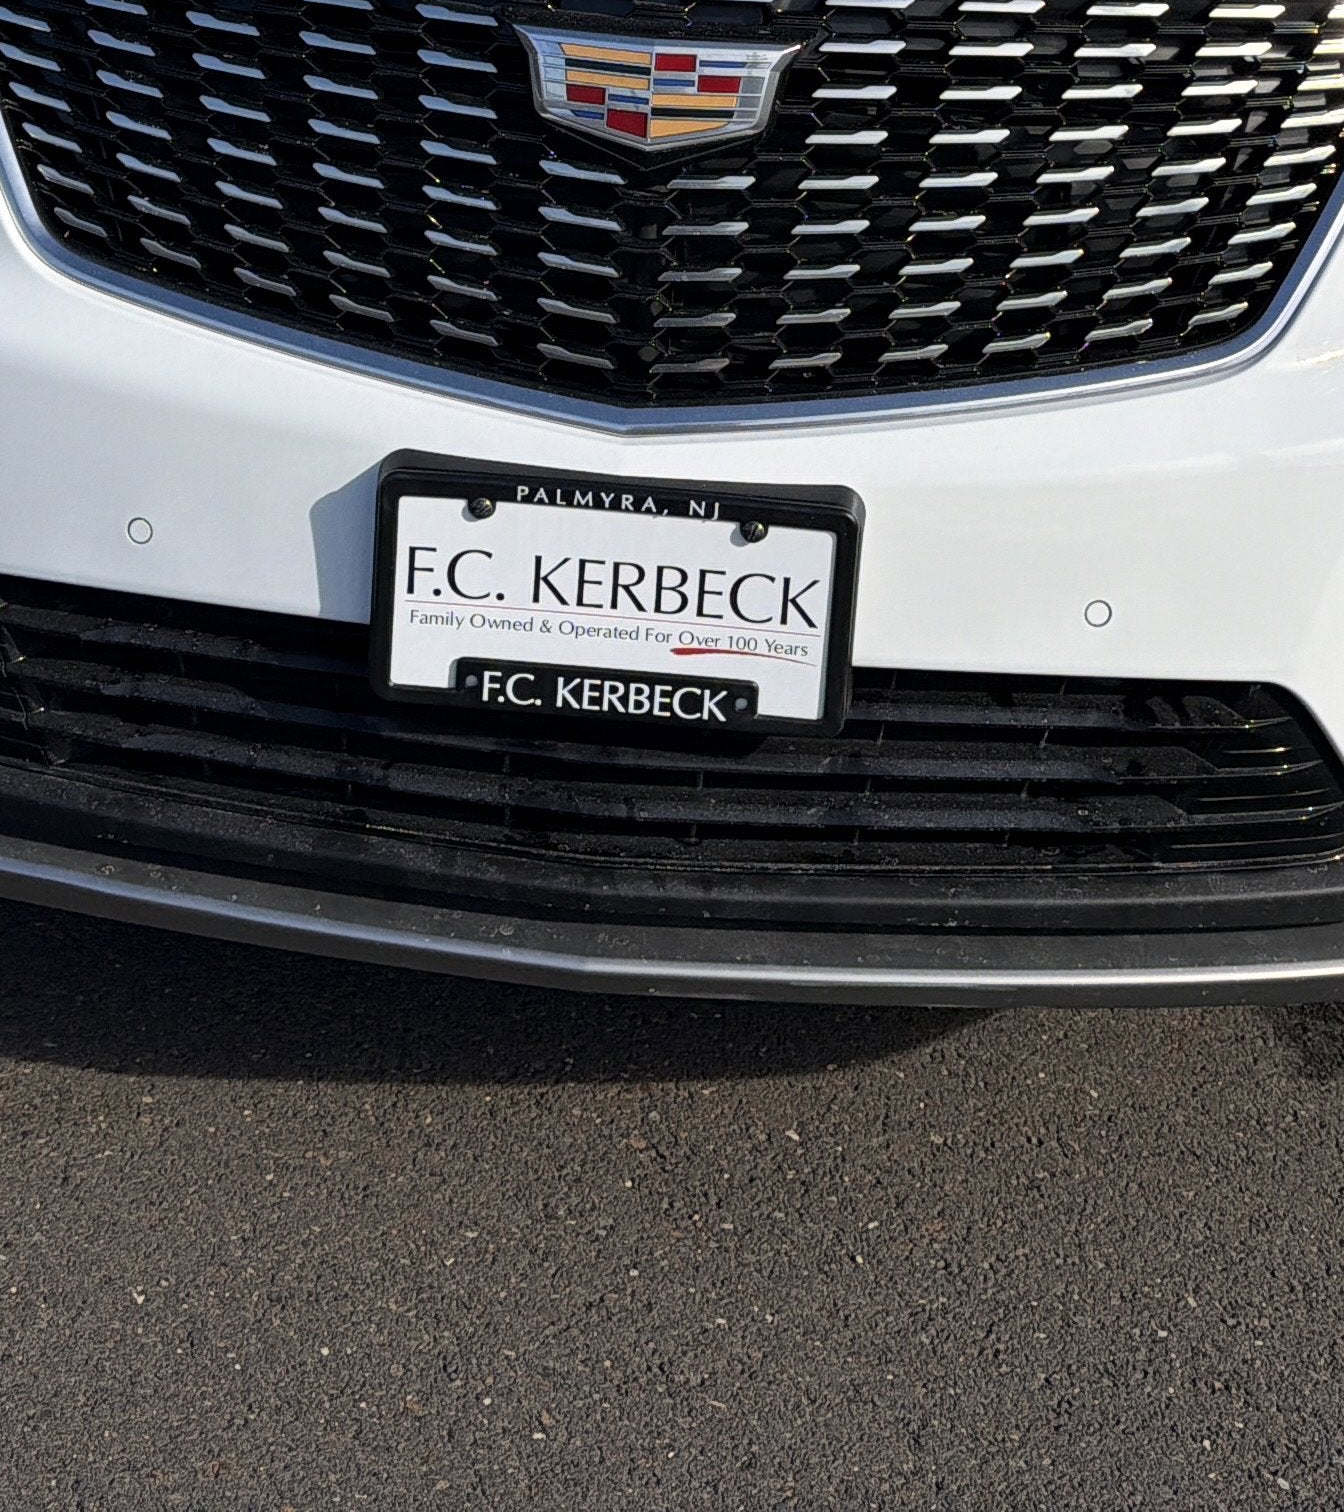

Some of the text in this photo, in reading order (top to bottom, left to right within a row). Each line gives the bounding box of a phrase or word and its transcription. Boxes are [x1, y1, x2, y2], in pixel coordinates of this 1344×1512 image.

[517, 485, 720, 520] PALMYRA, NJ
[406, 545, 821, 629] F.C. KERBECK
[410, 609, 809, 657] Family Owned & Operated For Over 100 Years
[481, 670, 728, 722] F.C. KERBECK
